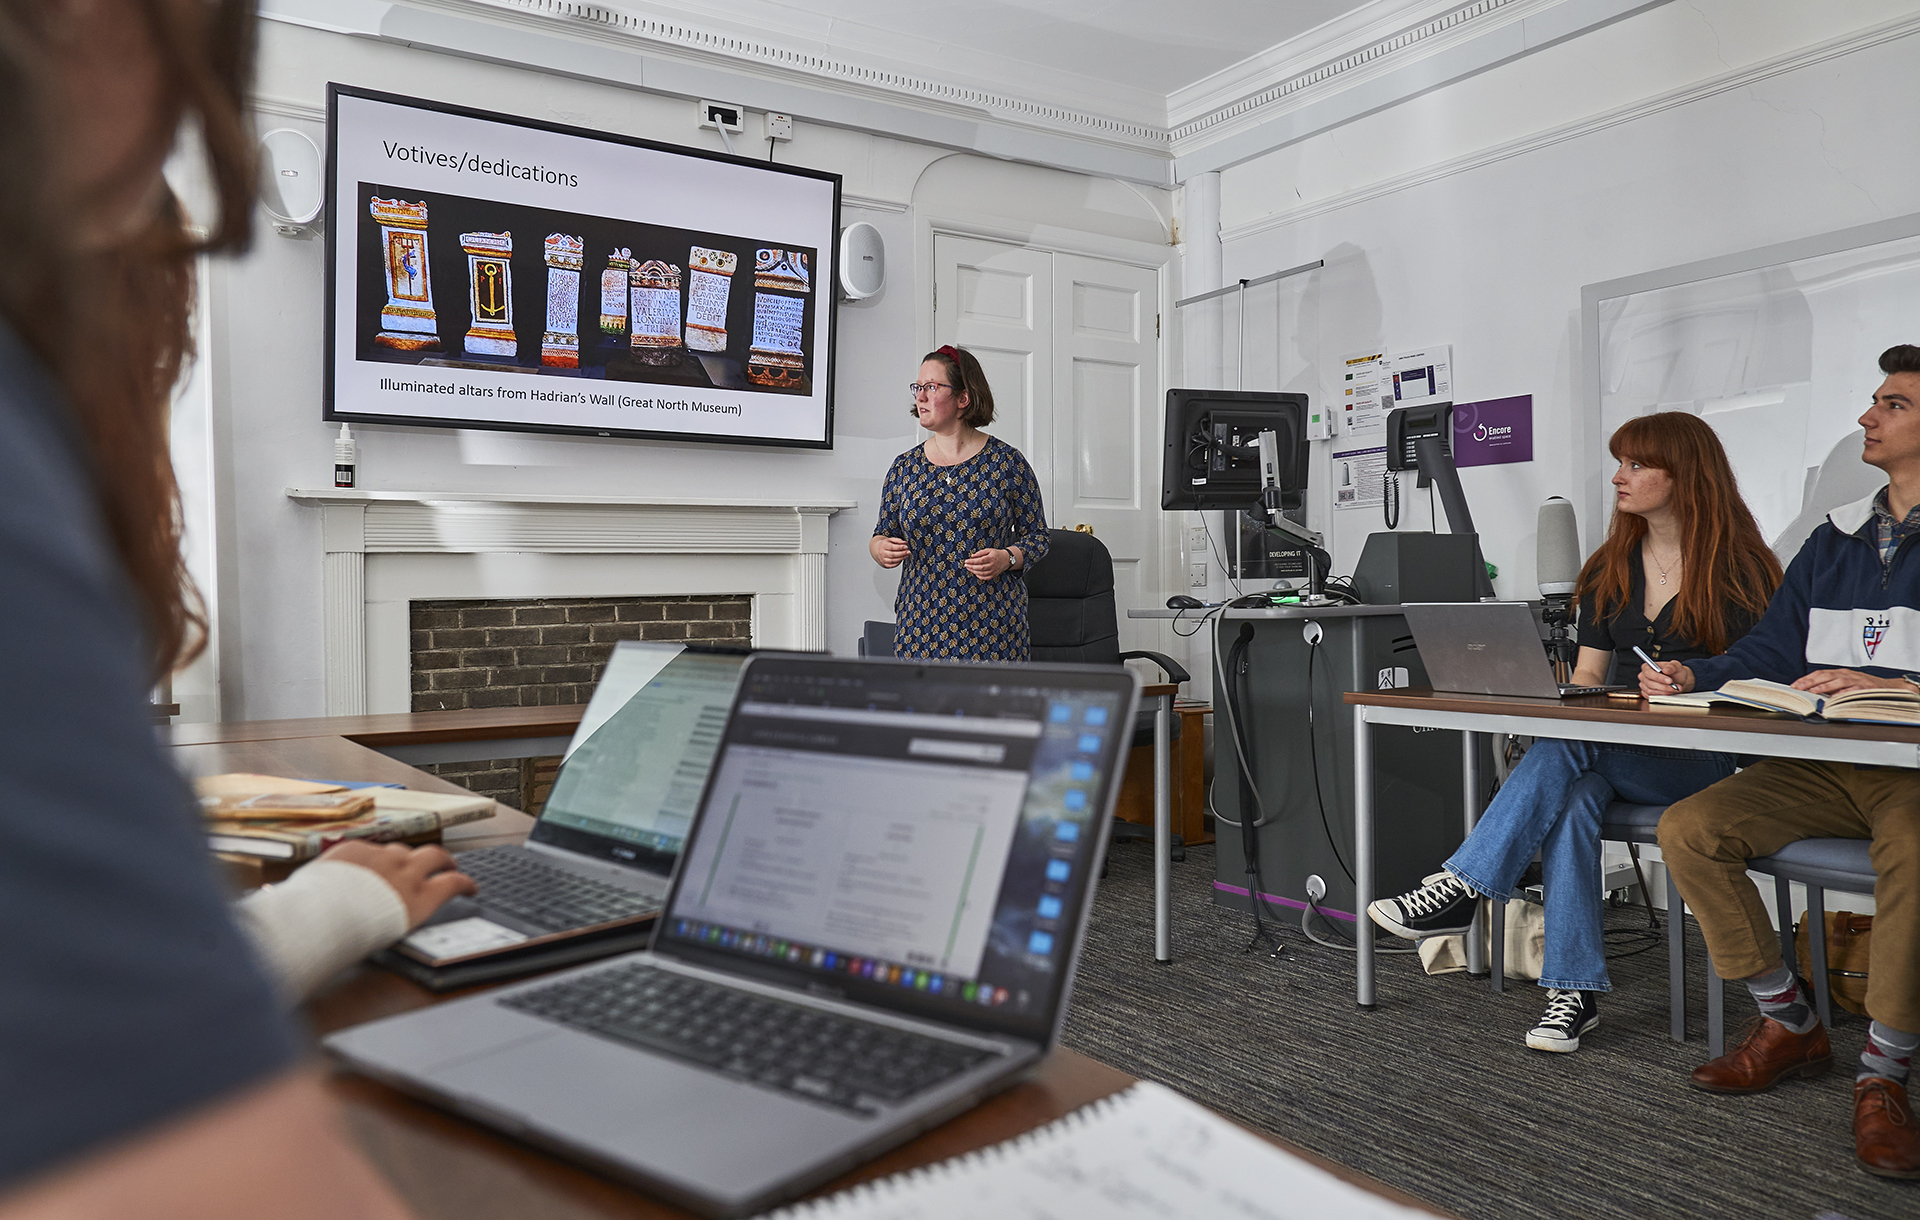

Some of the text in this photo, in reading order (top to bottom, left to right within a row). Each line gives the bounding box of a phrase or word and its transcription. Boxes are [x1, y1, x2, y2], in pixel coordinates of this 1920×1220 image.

[383, 140, 578, 188] Votives/dedications
[380, 378, 742, 417] Illuminated altars from Hadrian’s Wall (Great North Museum)
[1488, 426, 1512, 436] Encore
